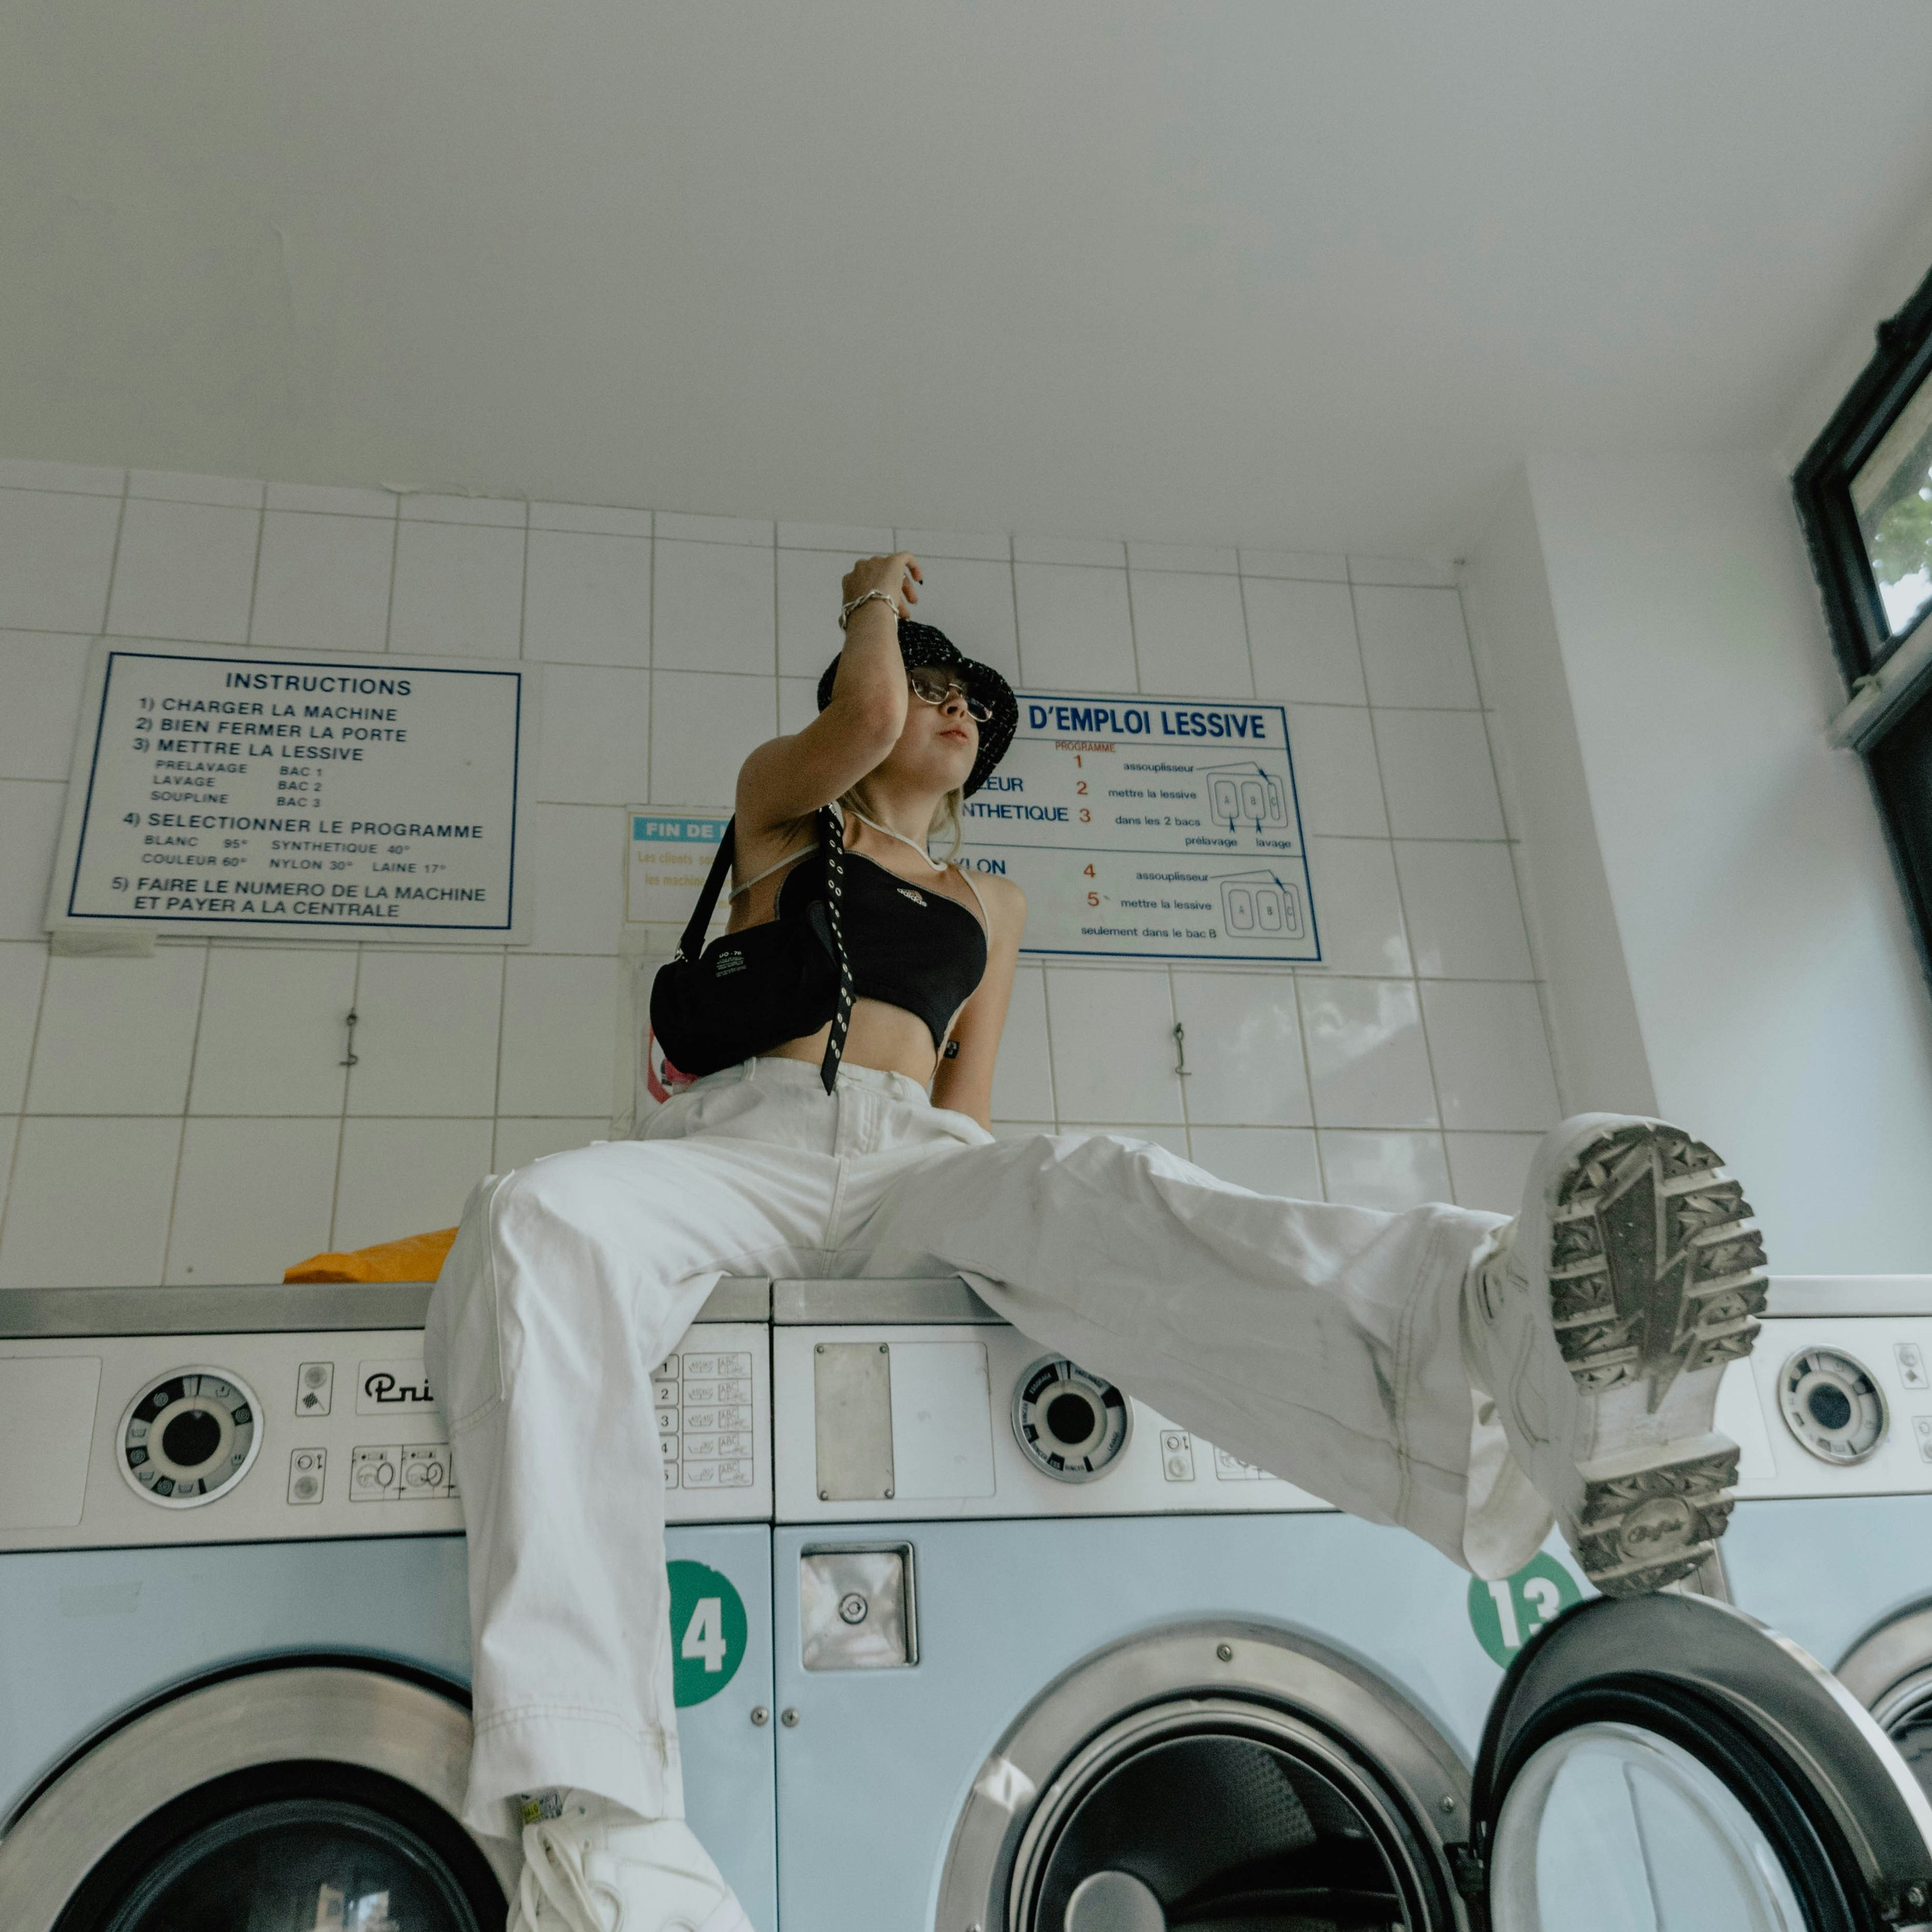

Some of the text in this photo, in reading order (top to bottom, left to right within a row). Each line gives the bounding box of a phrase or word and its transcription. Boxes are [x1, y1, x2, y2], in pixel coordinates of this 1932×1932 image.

[226, 673, 411, 696] INSTRUCTIONS
[139, 697, 397, 721] 1) CHARGER LA MACHINE
[136, 717, 407, 742] 2) BIEN FERMER LA PORTE
[1029, 705, 1266, 739] D'EMPLOI LESSIVE
[134, 737, 363, 761] 3) METTRE LA LESSIVE
[1055, 740, 1115, 752] PROGRAMME
[155, 760, 322, 777] PRELAVAGE BAC 1
[1075, 755, 1081, 768] 1
[1124, 763, 1194, 773] assouplisseur
[153, 776, 322, 792] LAVAGE BAC 2
[980, 777, 1023, 792] EUR
[1077, 781, 1088, 795] 2
[151, 791, 321, 808] SOUPLINE BAC 3
[1109, 789, 1197, 799] mettre la lessive
[1079, 808, 1091, 823] 3
[1115, 816, 1201, 826] dans les 2 bacs
[123, 813, 482, 838] 4) SELECTIONNER LE PROGRAMME
[646, 823, 681, 838] FIN
[687, 824, 714, 838] DE
[144, 835, 198, 847] BLANC
[272, 840, 377, 854] SYNTHETIQUE
[1185, 836, 1237, 848] prélavage
[1256, 838, 1291, 849] lavage
[142, 854, 217, 866] COULEUR
[270, 859, 322, 869] NYLON
[373, 863, 417, 873] LAINE
[638, 851, 656, 863] Les
[1084, 864, 1096, 878] 4
[1136, 872, 1208, 883] assouplisseur
[112, 877, 485, 901] 5) FAIRE LE NUMERO DE LA MACHINE
[897, 888, 928, 907] adidas
[1088, 891, 1100, 907] 5
[1121, 900, 1212, 910] mettre la lessive
[134, 896, 399, 917] ET PAYER A LA CENTRALE
[1081, 926, 1217, 938] seulement dans le bac B
[661, 1389, 669, 1400] 2
[661, 1415, 669, 1427] 3
[1487, 1577, 1560, 1648] 13
